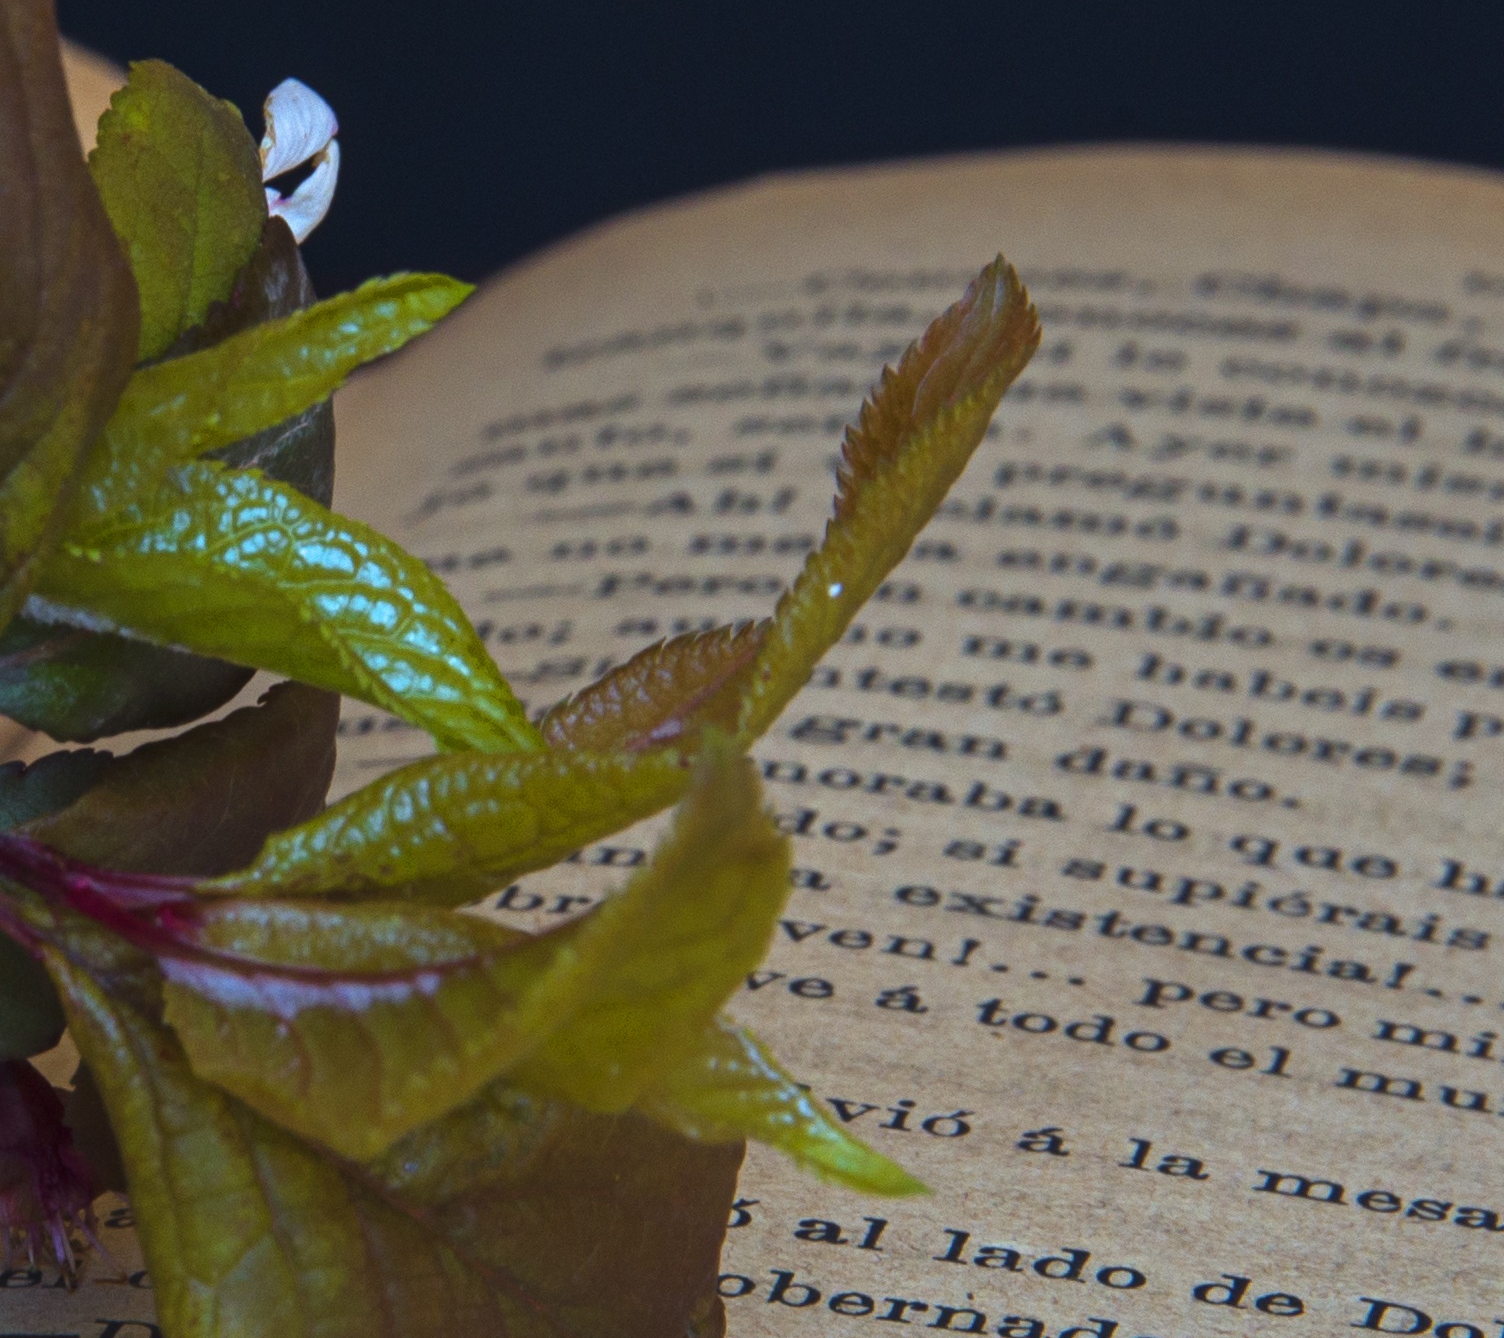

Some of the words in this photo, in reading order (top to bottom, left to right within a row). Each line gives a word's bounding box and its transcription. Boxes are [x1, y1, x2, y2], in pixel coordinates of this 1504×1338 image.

[1308, 639, 1400, 669] os
[789, 716, 1007, 761] gran
[1054, 747, 1299, 809] daño.
[1109, 700, 1471, 790] Dolores;
[1110, 804, 1190, 842] lo
[1230, 835, 1398, 879] que
[1062, 859, 1490, 951] supiérais
[875, 986, 928, 1014] á
[978, 998, 1170, 1053] todo
[1209, 1046, 1290, 1077] el
[1138, 978, 1341, 1029] pero
[1016, 1127, 1069, 1157] á
[1119, 1138, 1209, 1181] la
[793, 1217, 887, 1251] al
[934, 1228, 1147, 1290] lado
[1192, 1274, 1304, 1317] de
